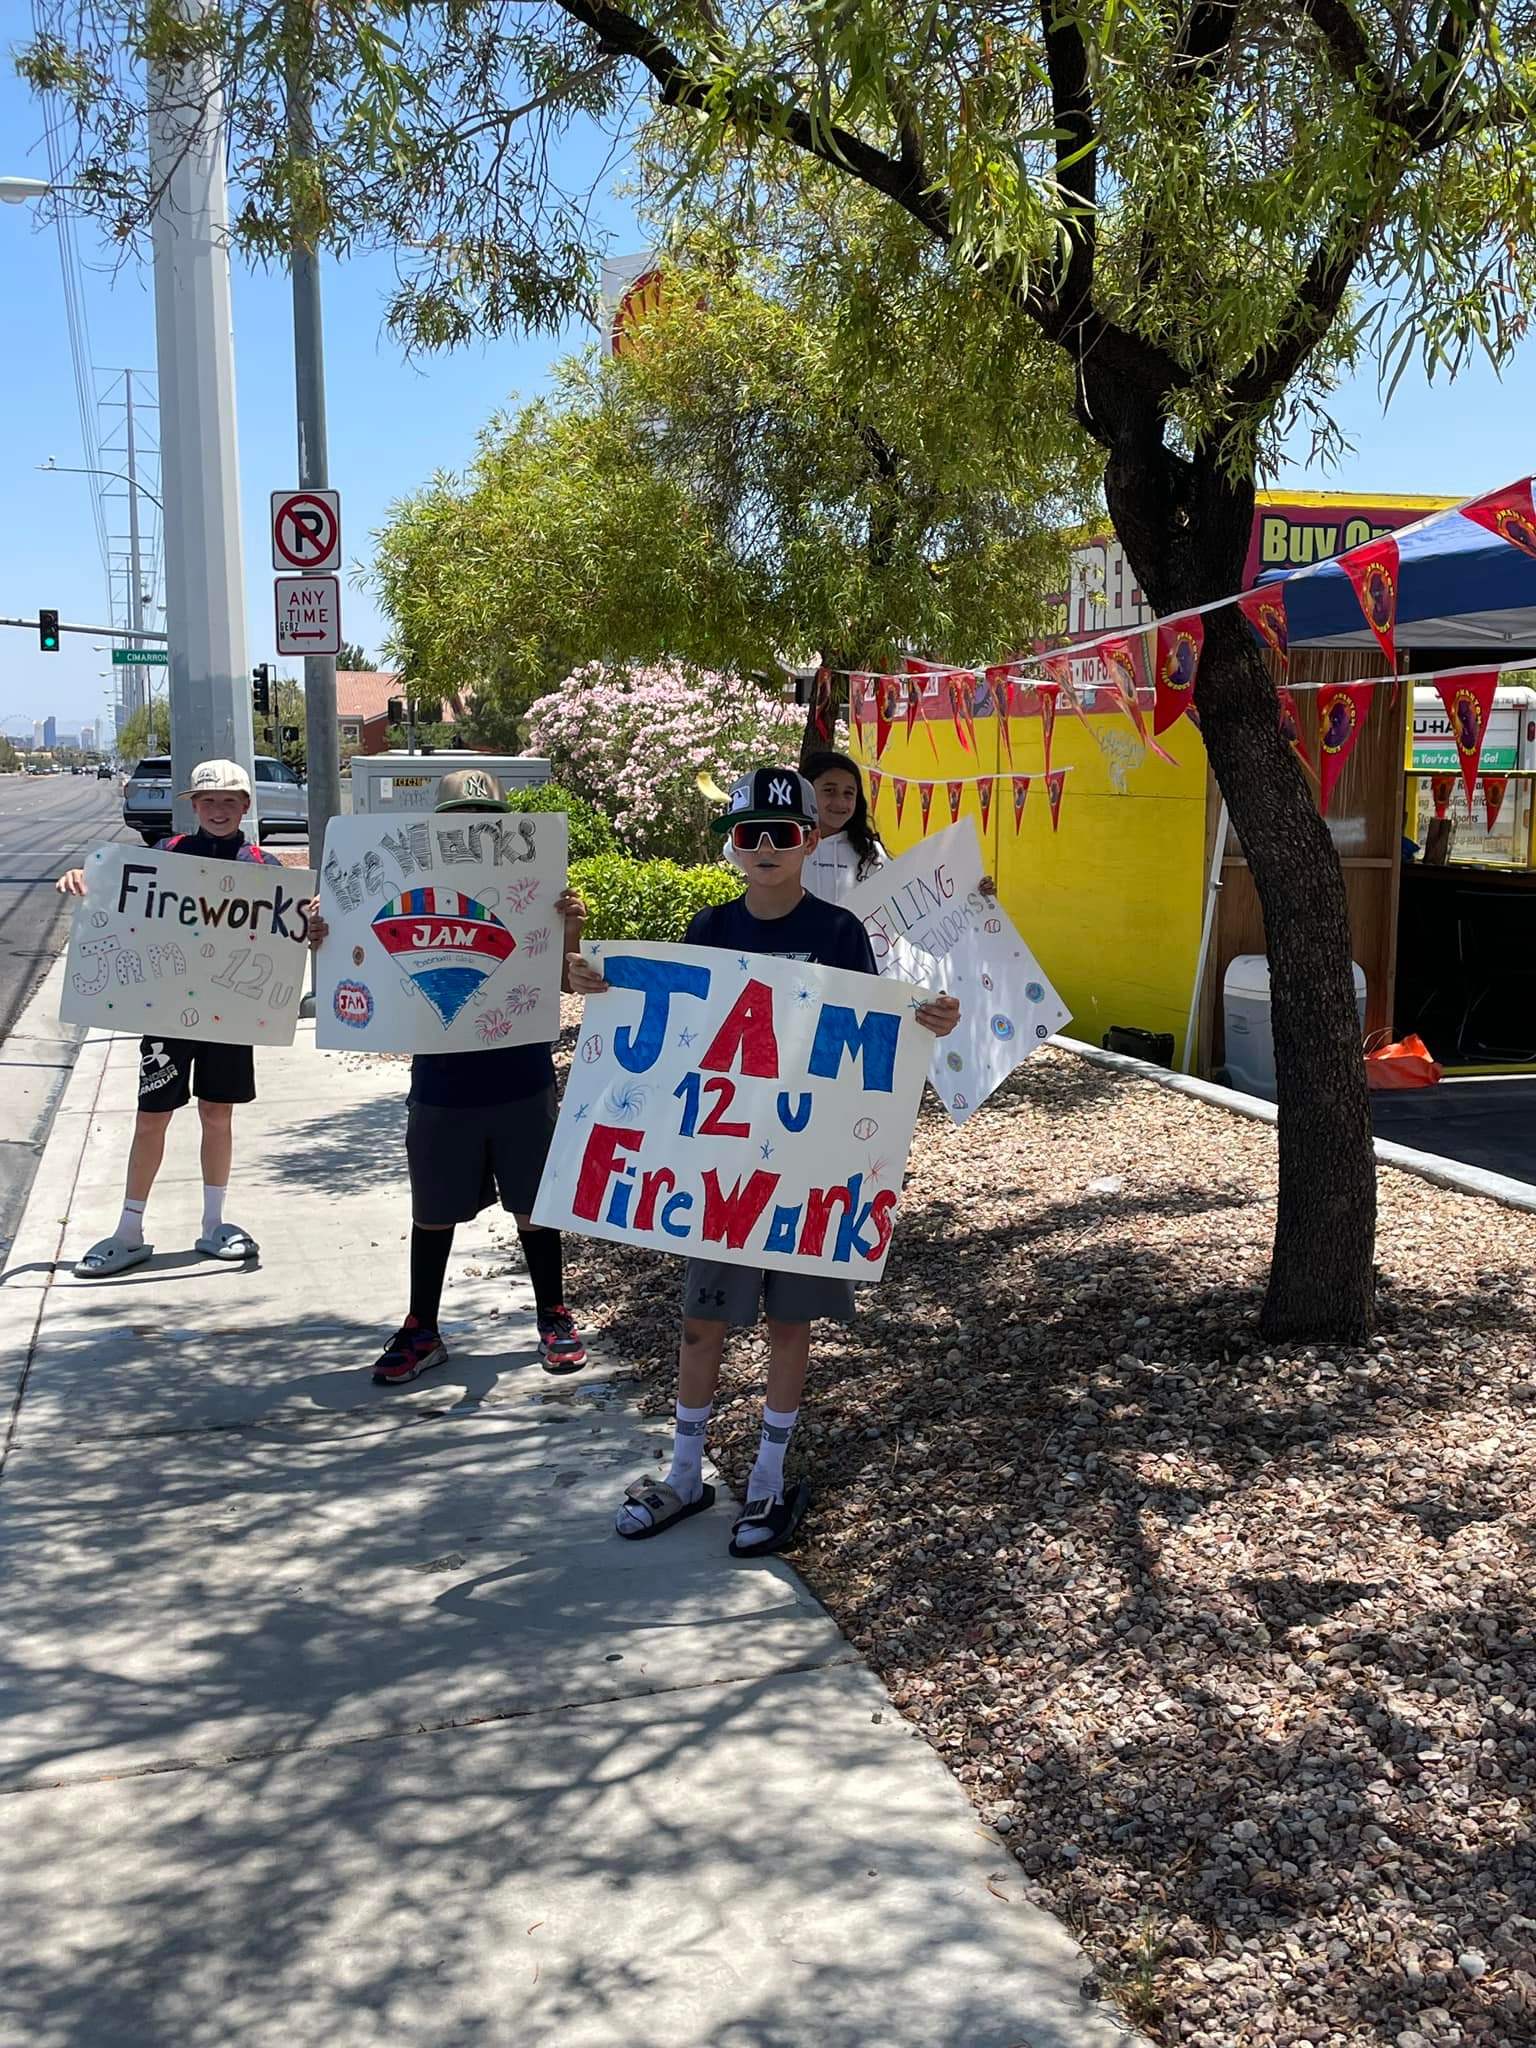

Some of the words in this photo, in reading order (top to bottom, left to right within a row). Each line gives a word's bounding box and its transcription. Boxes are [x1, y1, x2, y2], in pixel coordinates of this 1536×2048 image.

[1262, 518, 1338, 562] Buy
[289, 590, 325, 605] ANY
[287, 608, 328, 623] TIME
[127, 653, 168, 662] CIMARRON
[1413, 720, 1453, 733] U-HA
[1421, 752, 1449, 764] You're
[768, 777, 792, 805] NY
[118, 863, 314, 944] Fireworks
[862, 864, 955, 958] SELLING
[411, 923, 479, 947] JAM
[339, 990, 367, 1010] JAM
[603, 955, 901, 1093] JAM
